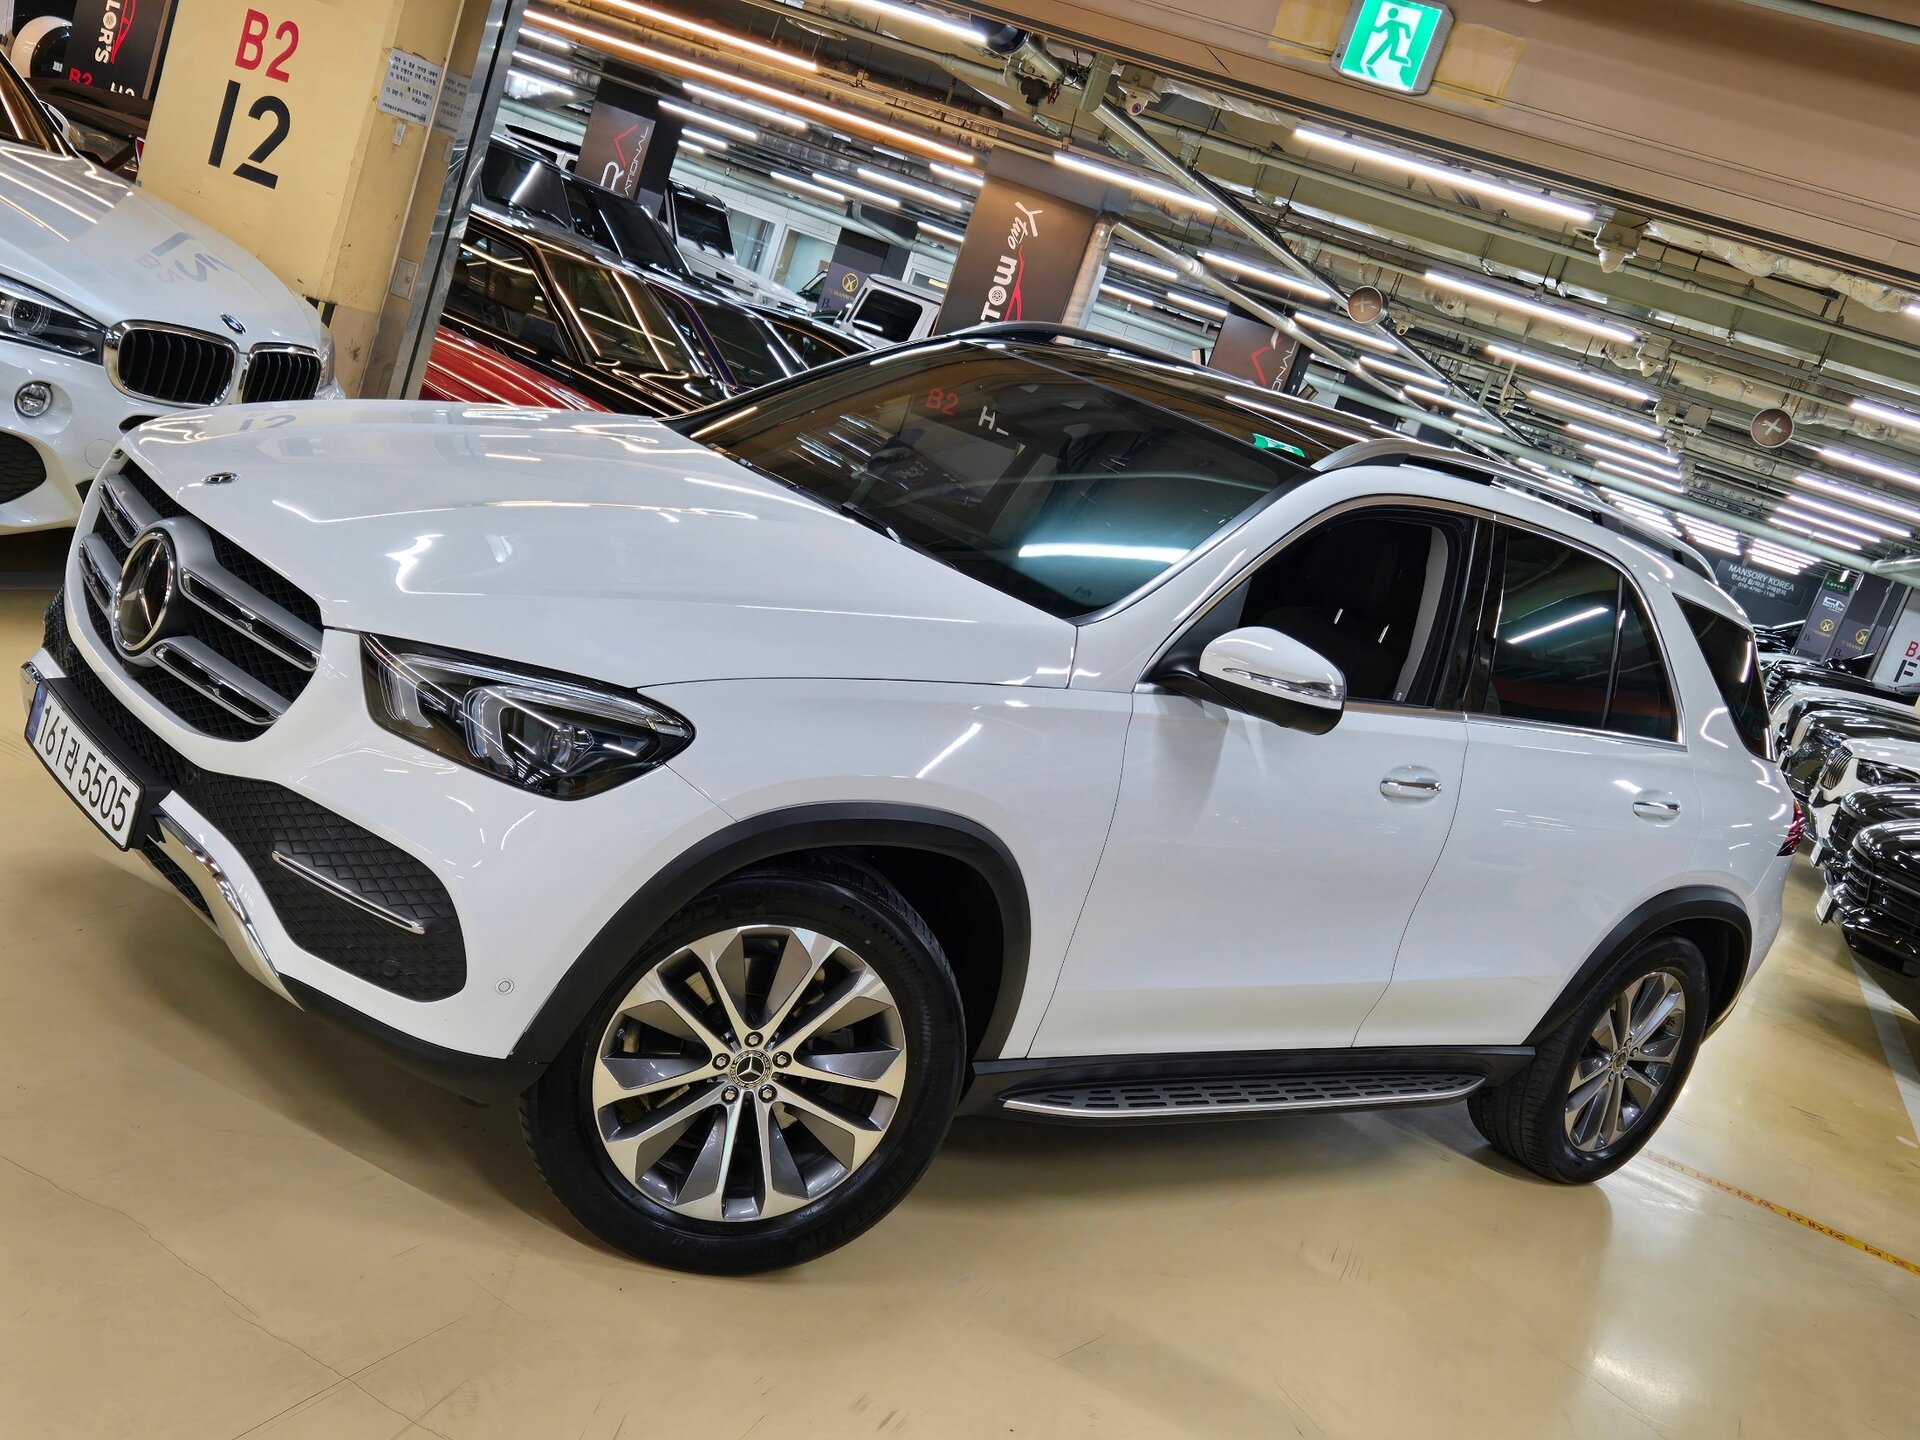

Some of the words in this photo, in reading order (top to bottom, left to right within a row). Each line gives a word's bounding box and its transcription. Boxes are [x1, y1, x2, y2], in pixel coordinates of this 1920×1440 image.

[234, 8, 299, 84] B2
[926, 385, 960, 416] B2
[1728, 564, 1770, 581] MANSORY
[1768, 577, 1795, 592] KOREA
[1905, 640, 1920, 661] B
[39, 705, 81, 780] 161라
[77, 751, 132, 832] 5505
